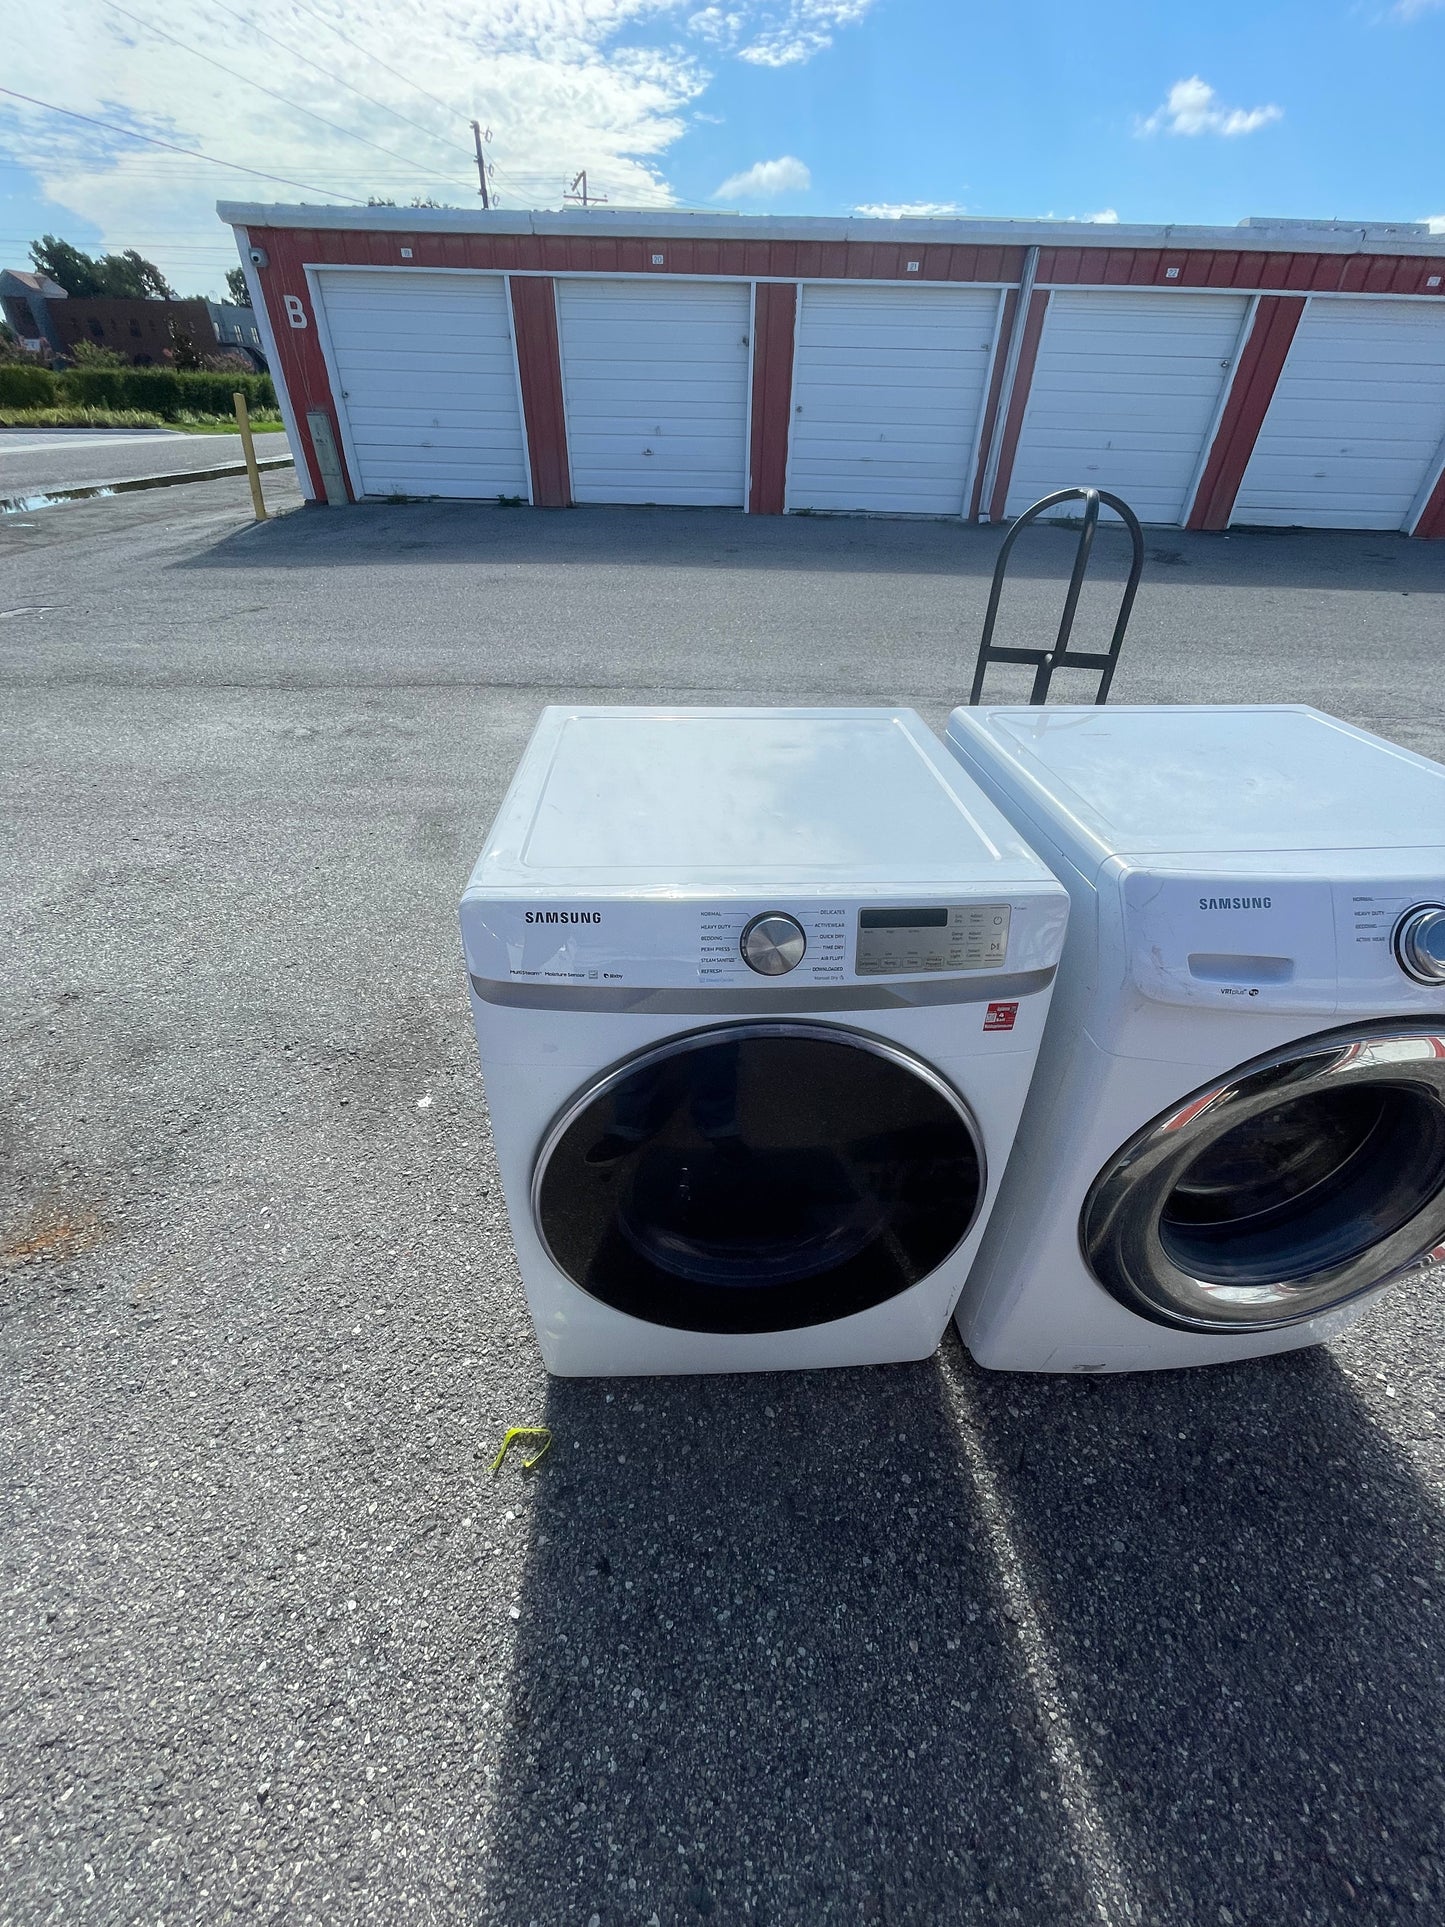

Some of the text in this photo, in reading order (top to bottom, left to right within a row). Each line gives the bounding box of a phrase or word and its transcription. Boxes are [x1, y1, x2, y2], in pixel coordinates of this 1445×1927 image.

[283, 295, 308, 329] B
[1199, 897, 1272, 910] SAMSUNG
[525, 911, 602, 924] SAMSUNG
